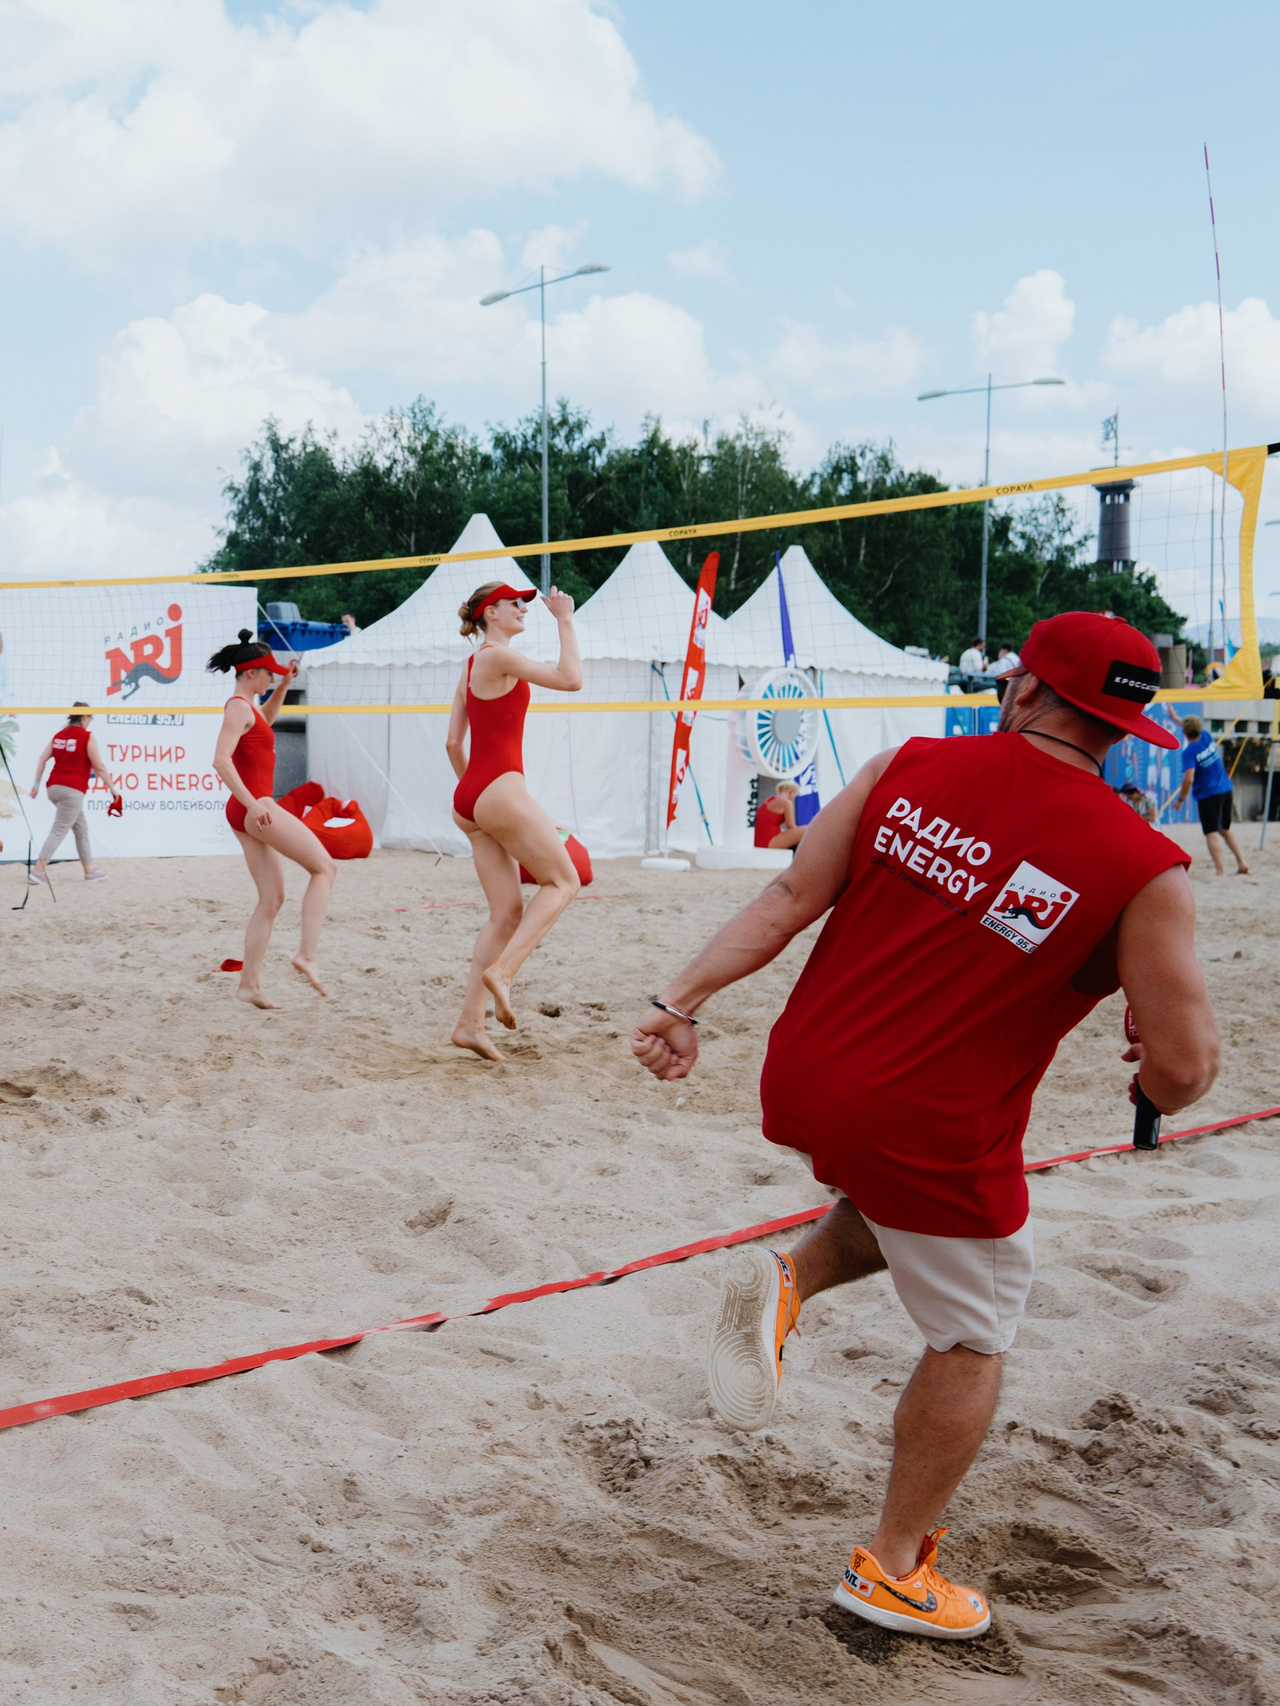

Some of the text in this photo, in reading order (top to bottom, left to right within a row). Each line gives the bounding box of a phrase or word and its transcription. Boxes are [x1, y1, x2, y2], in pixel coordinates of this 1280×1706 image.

[996, 483, 1034, 495] COPAYA
[668, 528, 698, 538] COPAYA
[418, 556, 442, 564] COPAYA
[104, 617, 165, 645] РАДИО
[106, 744, 186, 763] ТУРНИР
[159, 797, 227, 811] ВОЛЕЙБОЛУ
[886, 797, 992, 866] РАДИО
[873, 825, 989, 902] ENERGY
[1008, 882, 1057, 899] РАДИО
[981, 916, 1018, 941] ENERGY
